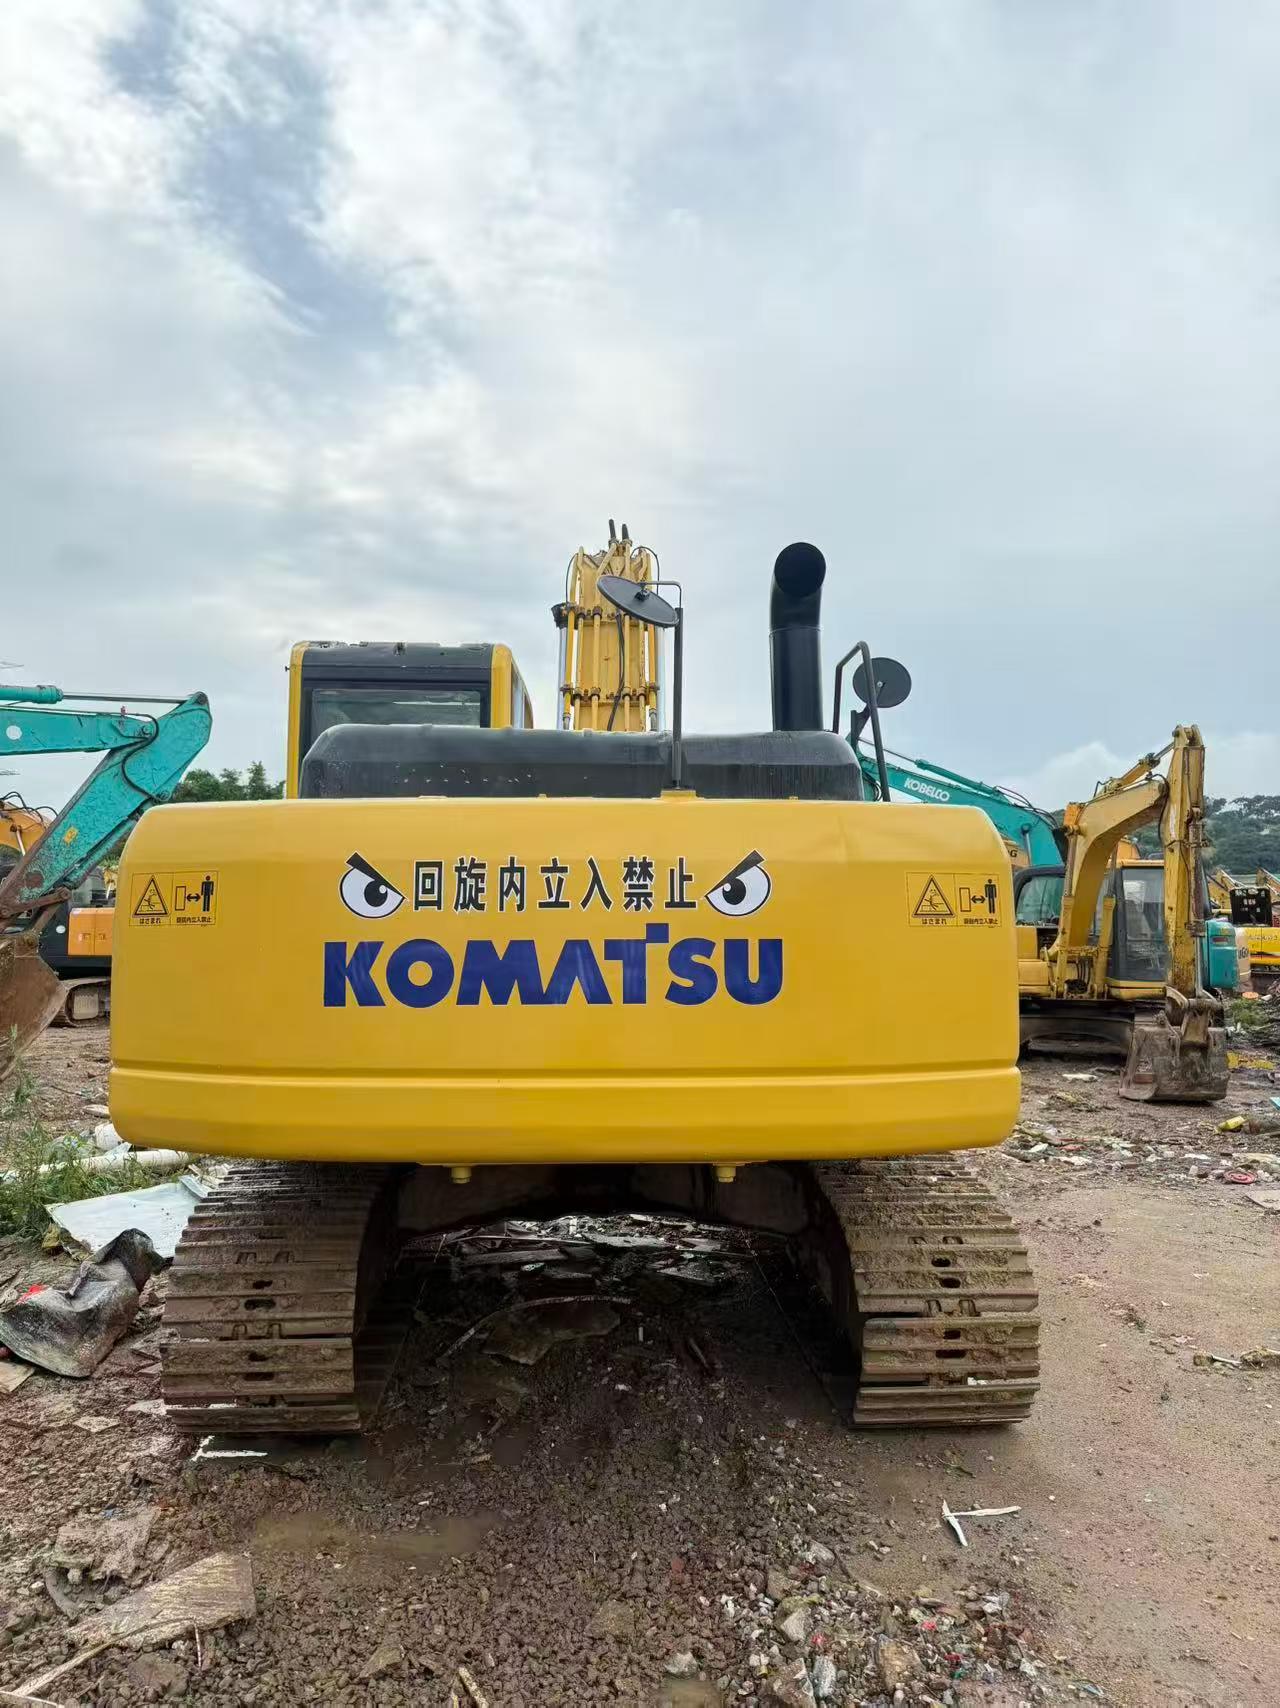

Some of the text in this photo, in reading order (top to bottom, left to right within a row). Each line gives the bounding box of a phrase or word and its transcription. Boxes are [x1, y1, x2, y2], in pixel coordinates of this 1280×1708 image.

[904, 777, 950, 802] KOBELCO
[412, 857, 697, 912] 回旋内立入禁止
[323, 923, 783, 1008] KOMATSU
